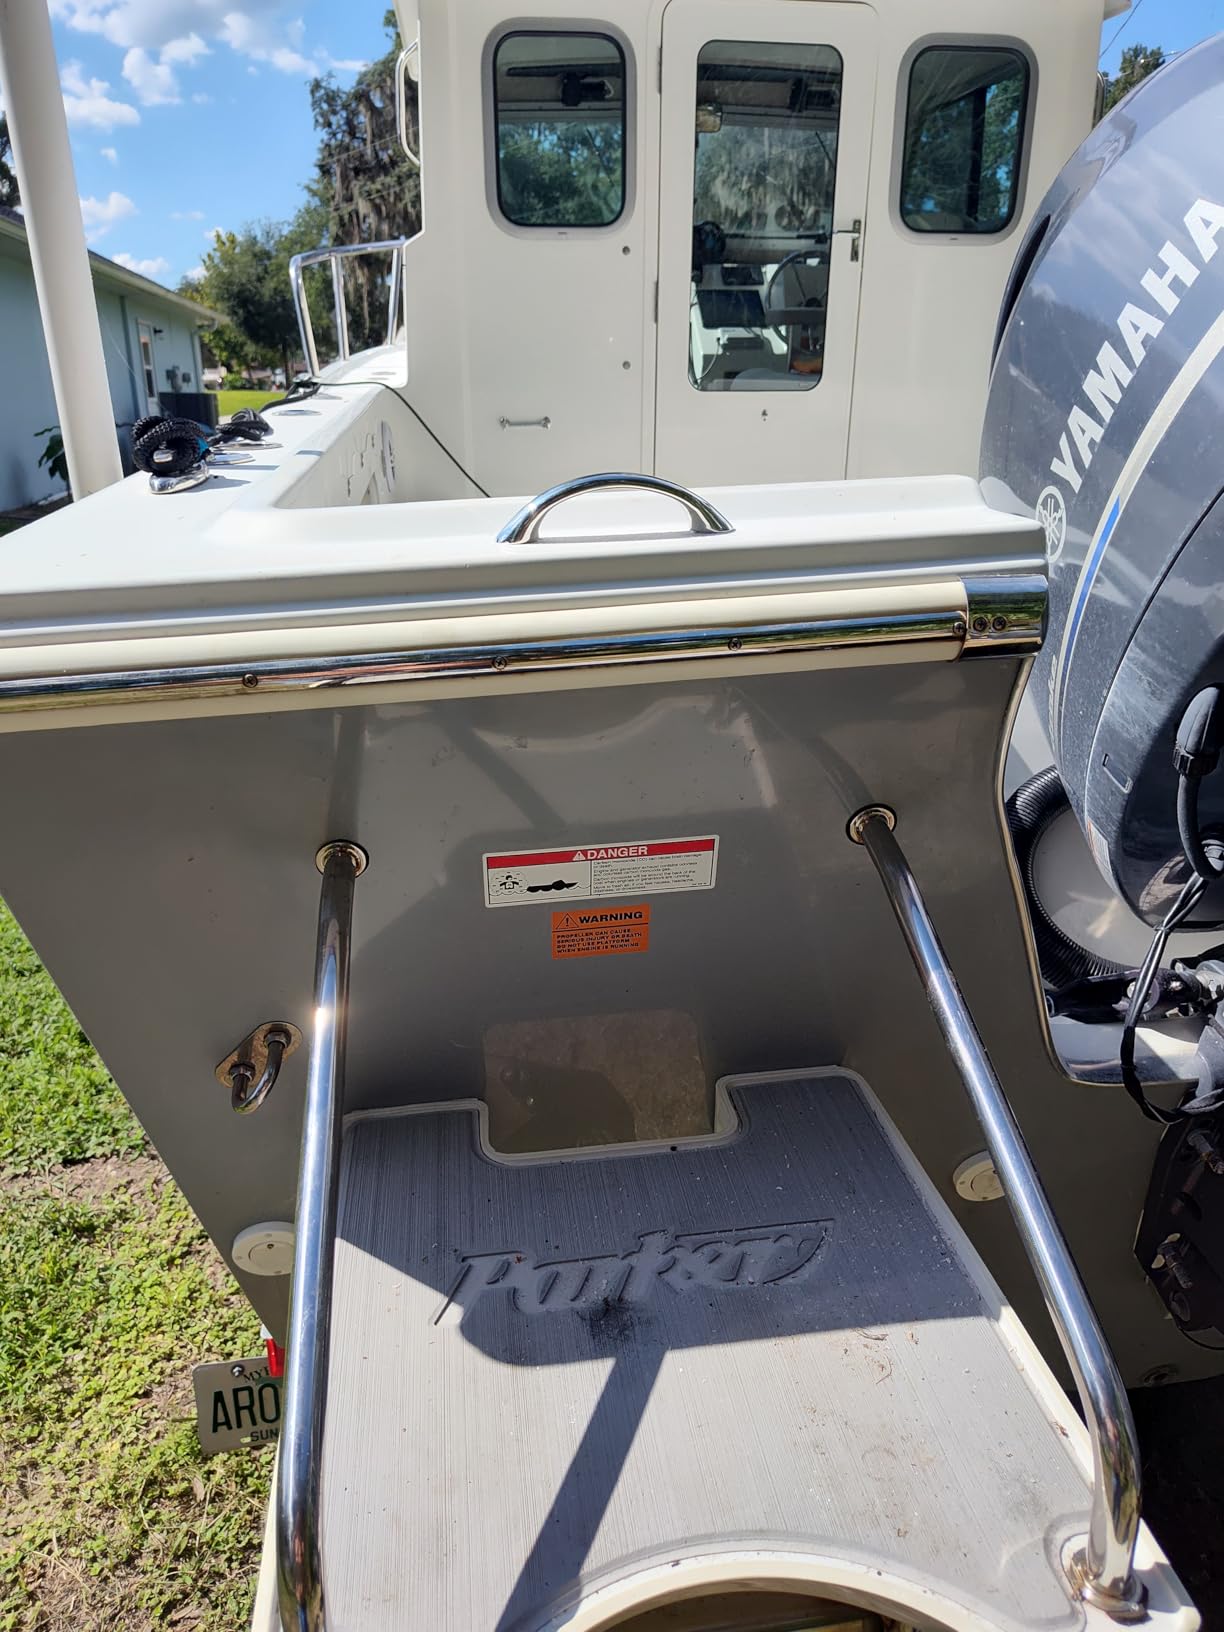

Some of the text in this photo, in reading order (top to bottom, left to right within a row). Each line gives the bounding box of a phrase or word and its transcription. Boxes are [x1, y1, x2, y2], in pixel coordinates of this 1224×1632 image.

[1050, 198, 1224, 493] YAMAHA
[588, 846, 648, 860] DANGER
[579, 912, 642, 923] WARNING
